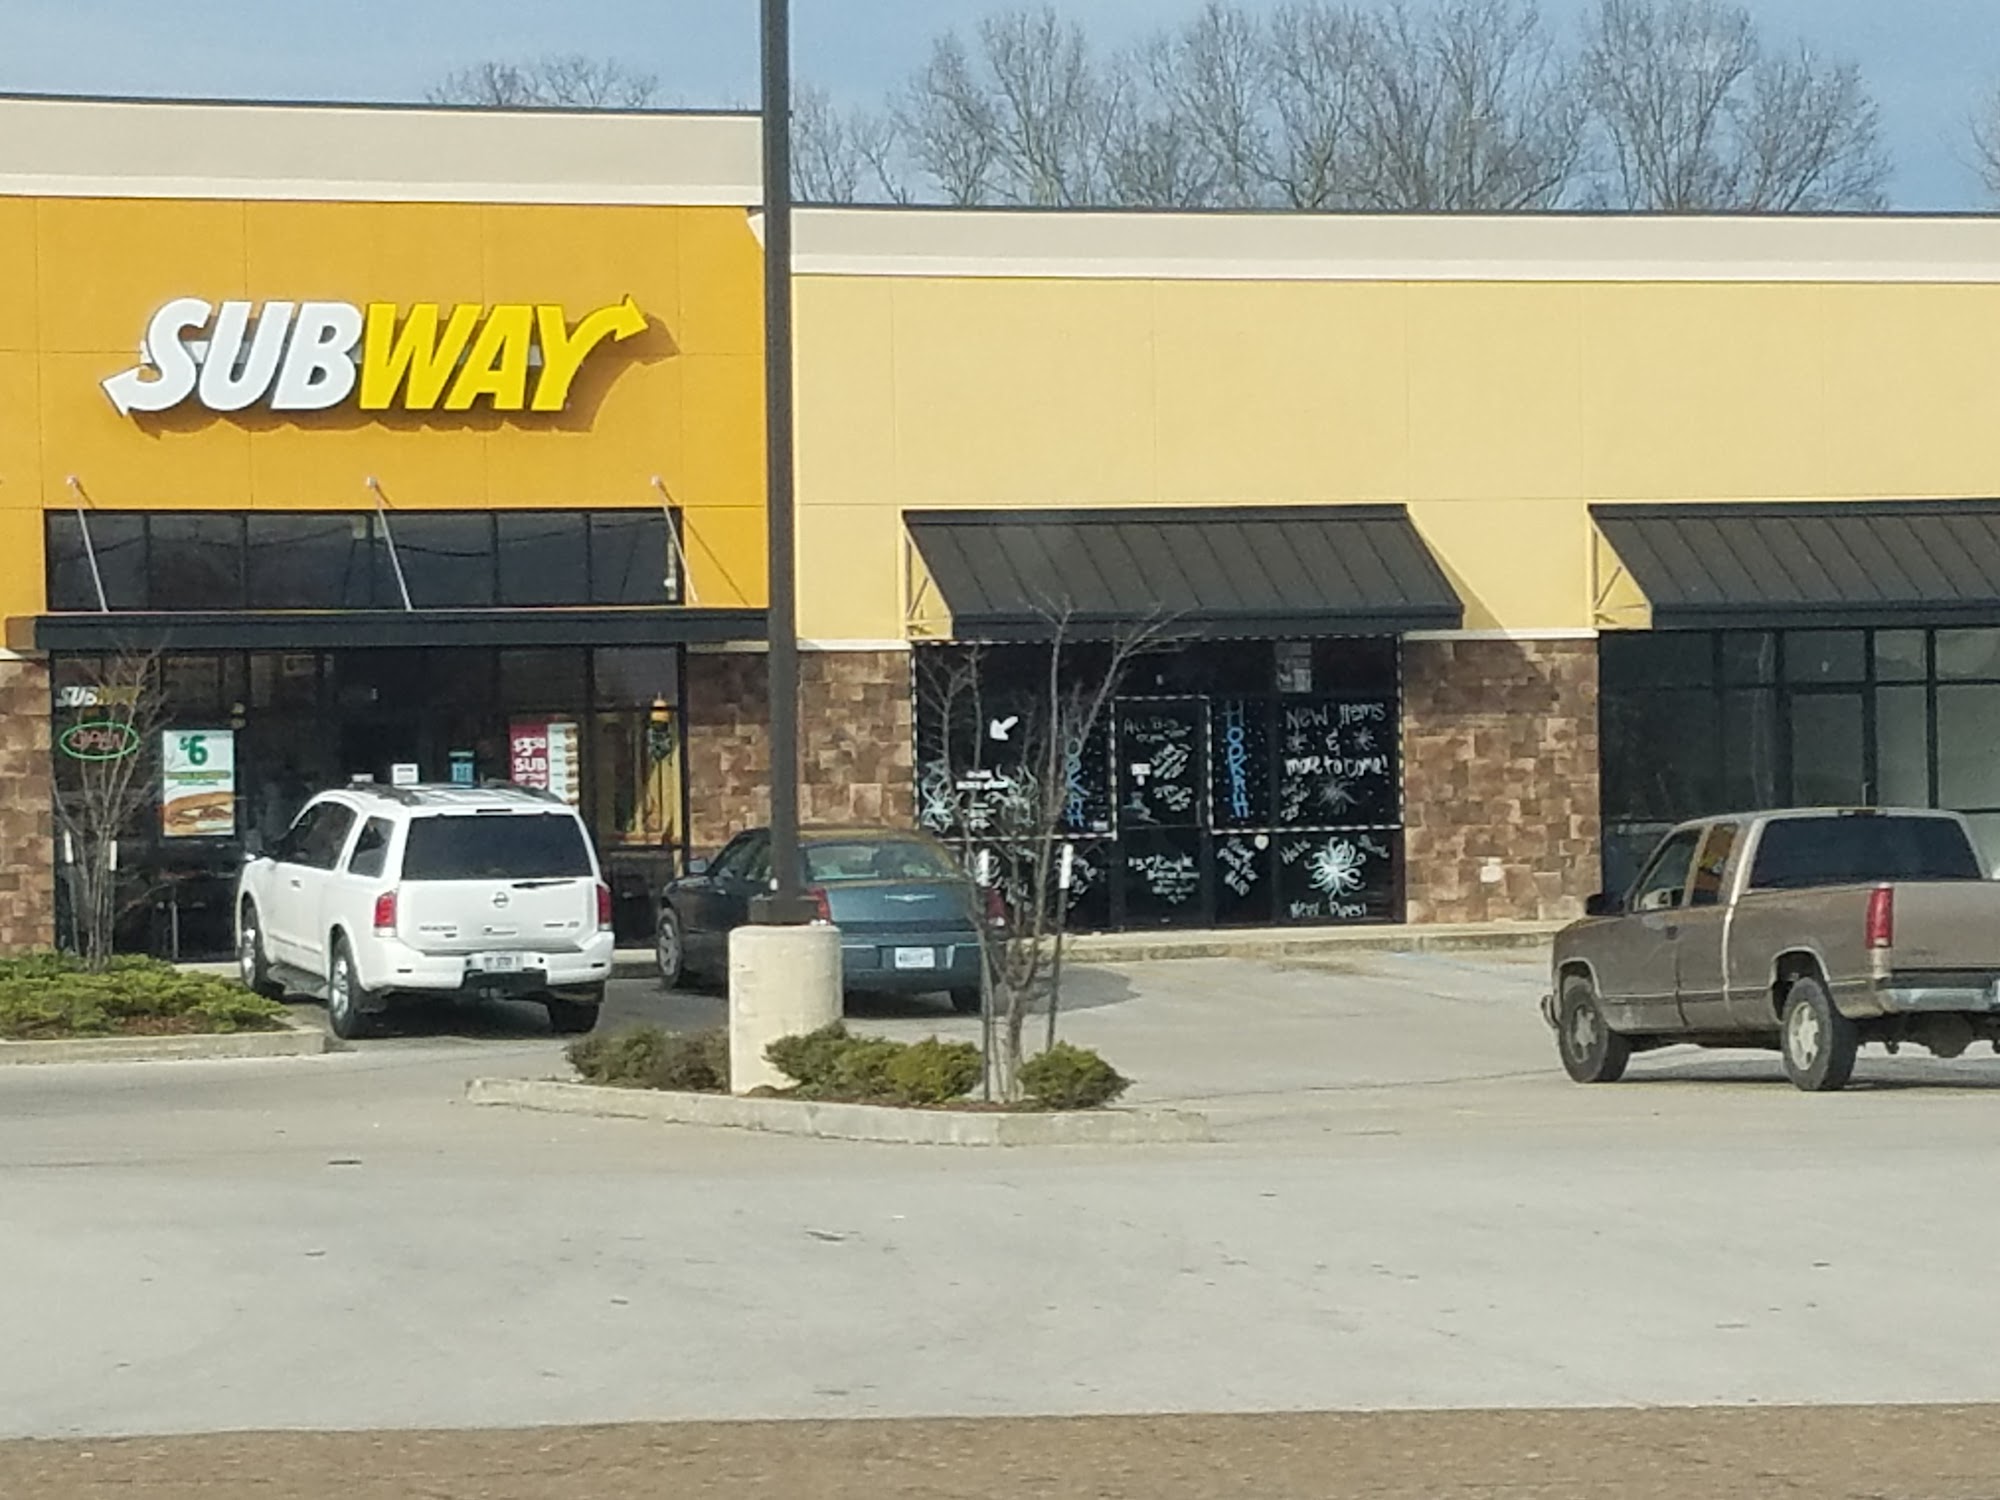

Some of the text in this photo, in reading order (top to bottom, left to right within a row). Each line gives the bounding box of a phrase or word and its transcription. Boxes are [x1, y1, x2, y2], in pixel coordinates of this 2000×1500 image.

[102, 294, 648, 416] SUBWAY
[179, 735, 208, 766] $6
[514, 757, 547, 773] SUB
